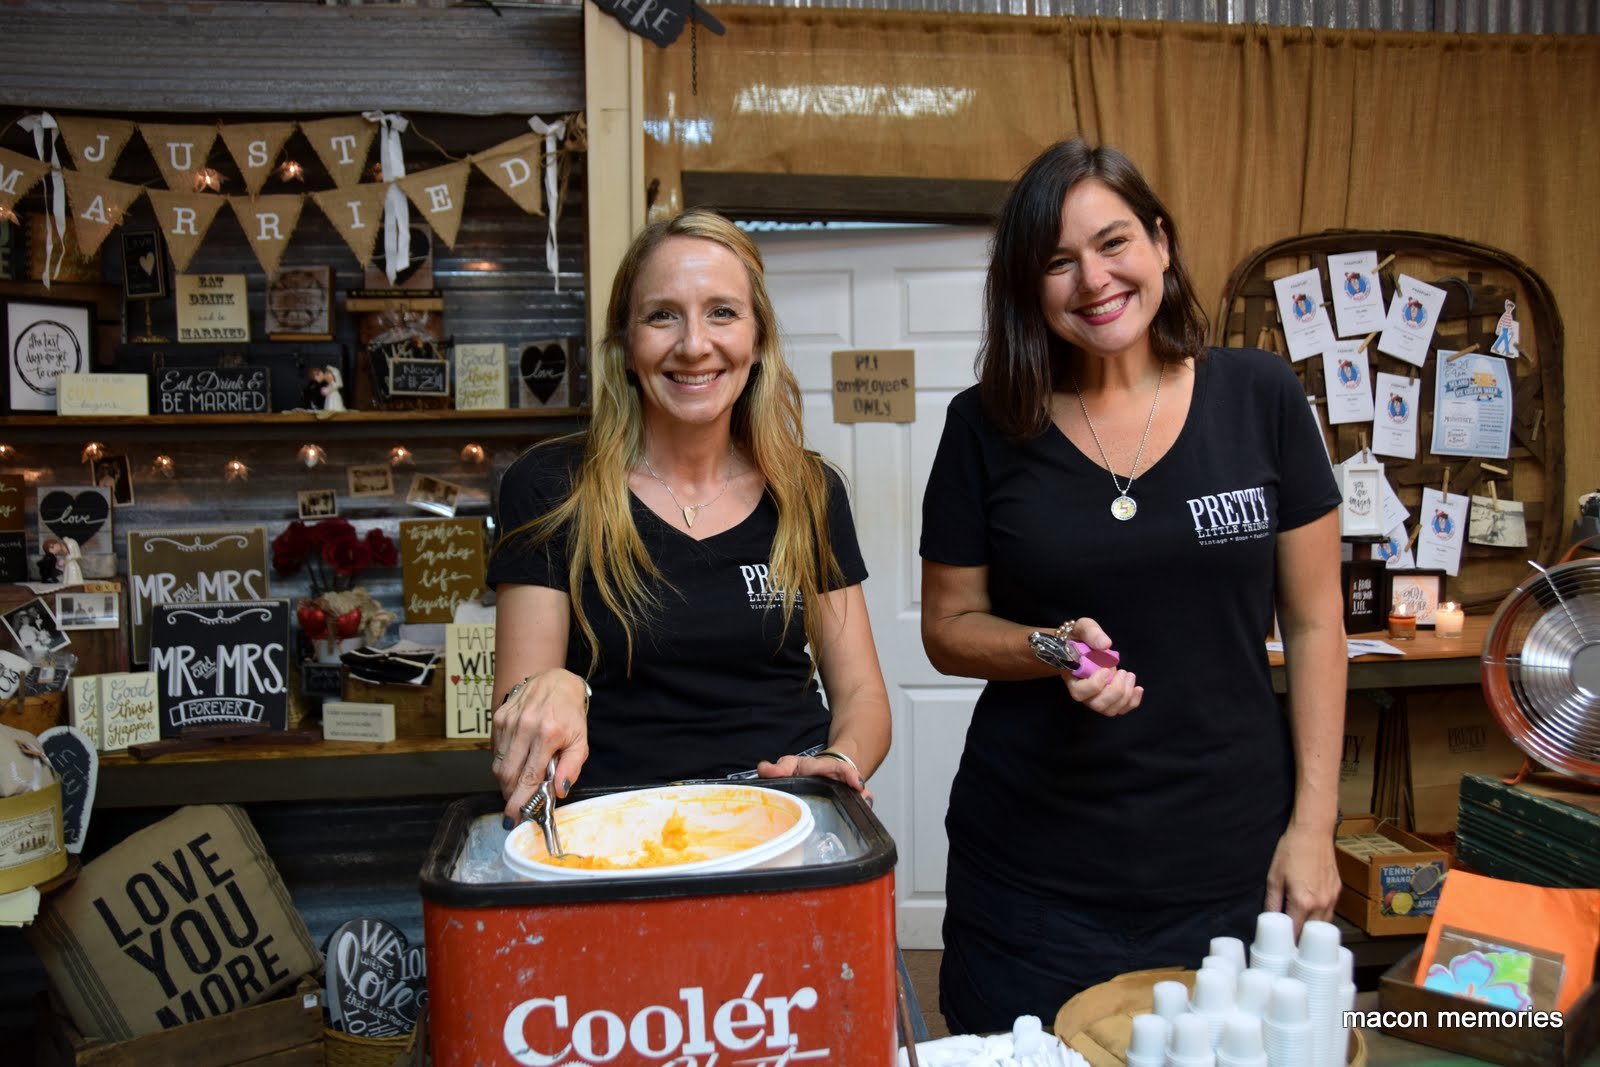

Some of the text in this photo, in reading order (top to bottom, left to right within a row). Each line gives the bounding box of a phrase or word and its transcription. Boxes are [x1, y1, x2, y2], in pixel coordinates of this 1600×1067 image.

[198, 275, 225, 288] EAT
[189, 293, 235, 305] DRINK
[180, 328, 246, 340] MARRIED
[196, 370, 245, 391] Drink
[246, 371, 264, 390] &
[162, 391, 266, 413] BE MARRIED
[1186, 486, 1270, 531] PRETTY
[406, 522, 475, 552] together
[1196, 521, 1270, 539] LITTLE THINGS
[411, 542, 476, 565] makes
[1198, 538, 1229, 547] Vintage
[418, 568, 472, 592] life
[457, 627, 496, 650] HAP
[190, 655, 217, 680] and
[216, 643, 287, 696] MRS.
[107, 678, 155, 712] Good
[111, 699, 154, 721] things
[188, 700, 244, 717] FOREVER
[1382, 867, 1416, 876] TENNIS
[93, 832, 235, 948] LOVE
[124, 880, 259, 999] YOU
[360, 956, 384, 974] with
[155, 934, 290, 1030] MORE
[344, 992, 413, 1033] that was more
